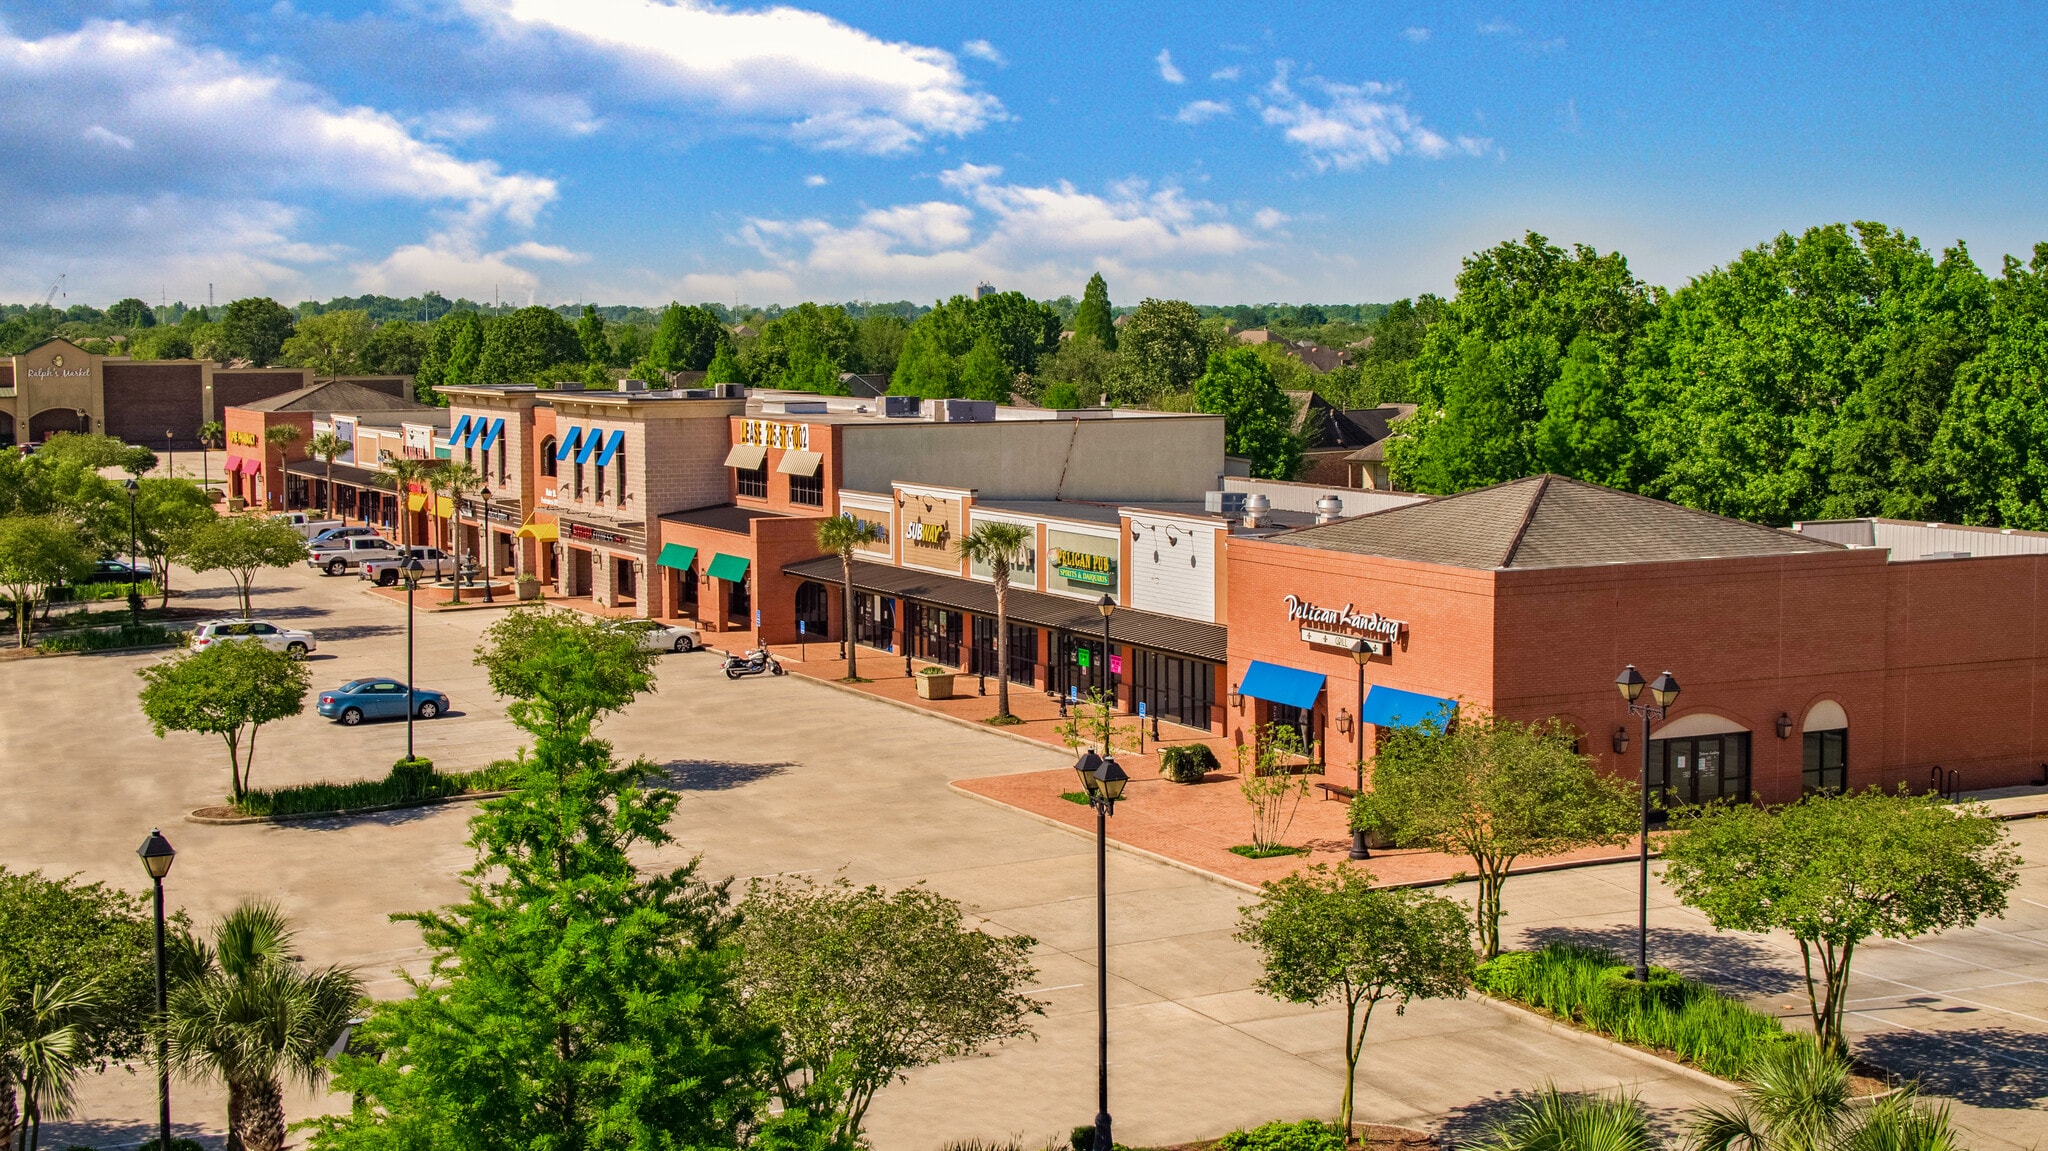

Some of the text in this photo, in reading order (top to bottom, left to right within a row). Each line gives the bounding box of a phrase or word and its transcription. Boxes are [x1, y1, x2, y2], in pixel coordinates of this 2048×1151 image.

[27, 366, 91, 381] Ralph's Market
[741, 421, 762, 445] LEASE
[906, 521, 943, 543] SUBWAY
[1057, 549, 1109, 572] PELICAN PUB
[1059, 569, 1077, 578] SPIRITS
[1283, 594, 1399, 642] Pelican Landing
